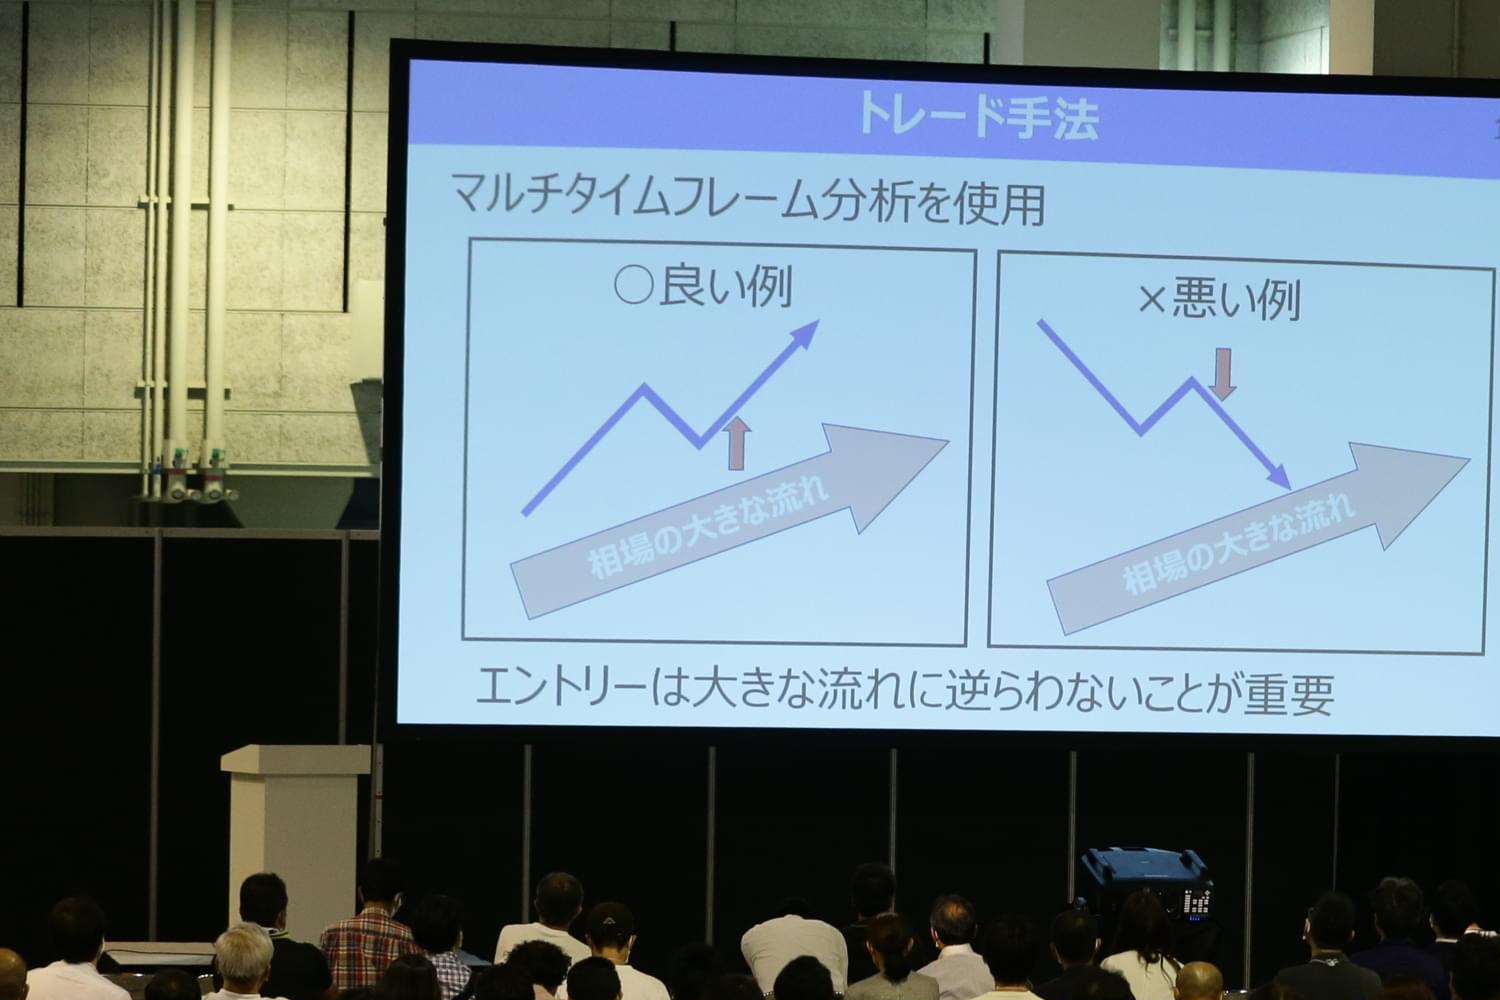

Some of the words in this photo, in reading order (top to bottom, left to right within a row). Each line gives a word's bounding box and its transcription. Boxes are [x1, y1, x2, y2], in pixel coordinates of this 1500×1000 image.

[862, 89, 1100, 141] トレード手法
[451, 172, 1045, 227] マルチタイムフレーム分析を使用
[588, 475, 830, 580] 相場の大きな流れ
[1122, 493, 1357, 596] 相場の大きな流れ
[476, 663, 1335, 717] エントリーは大きな流れに逆らわないことが重要
